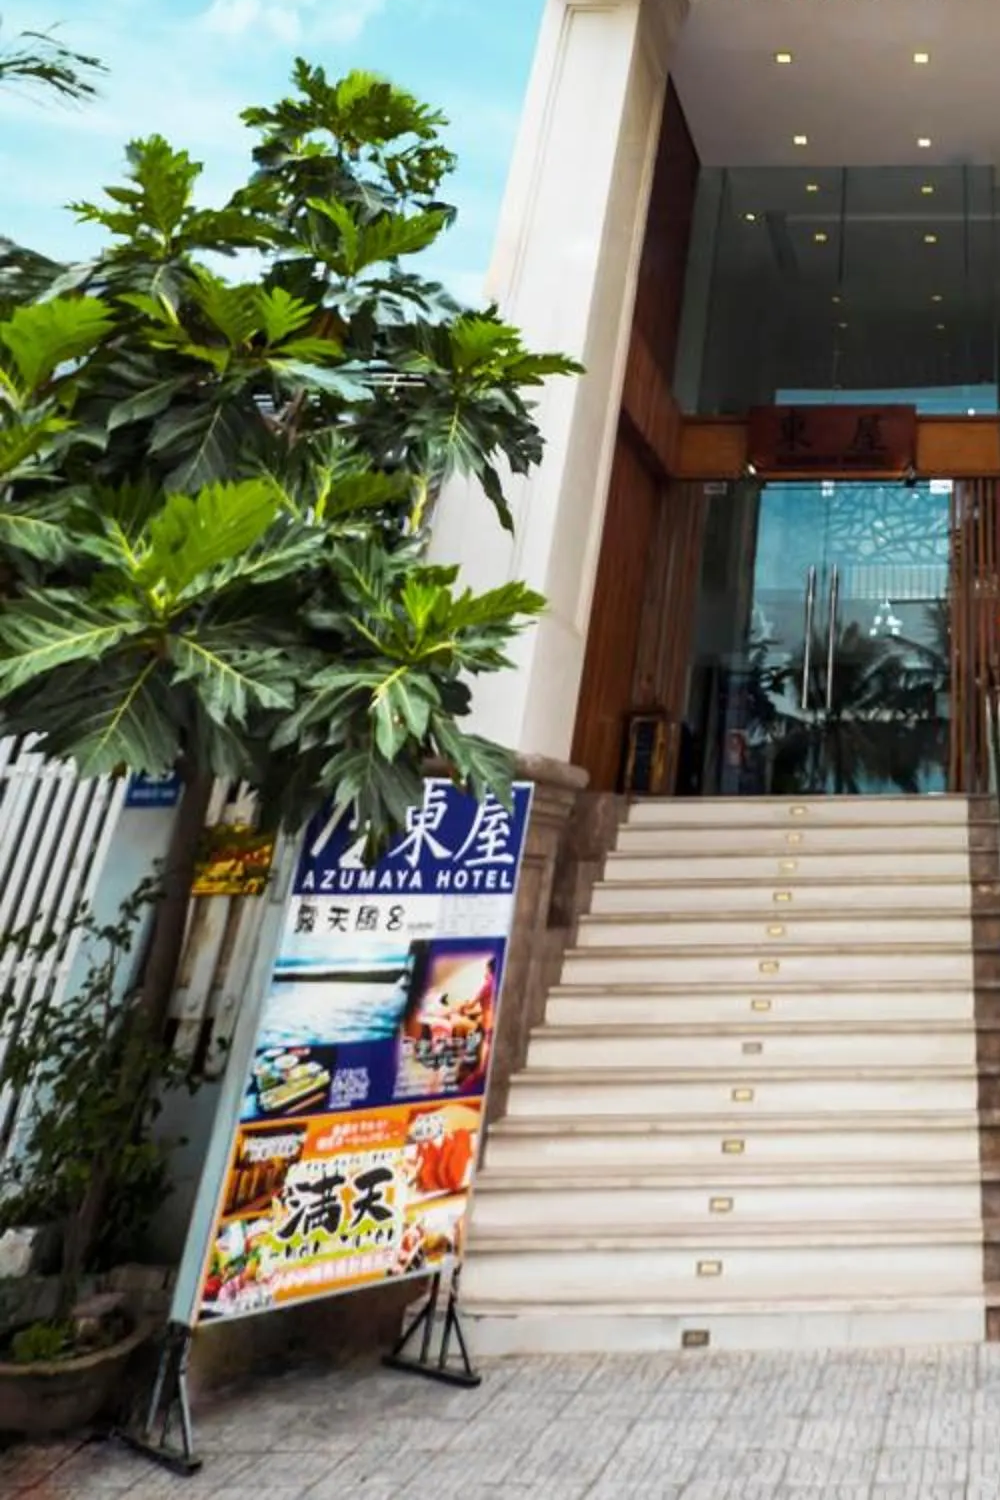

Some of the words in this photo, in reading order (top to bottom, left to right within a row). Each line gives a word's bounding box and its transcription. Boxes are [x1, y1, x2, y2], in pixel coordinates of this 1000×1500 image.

[302, 869, 423, 890] AZUMAYA
[436, 869, 513, 889] HOTEL
[277, 1167, 394, 1239] 満天
